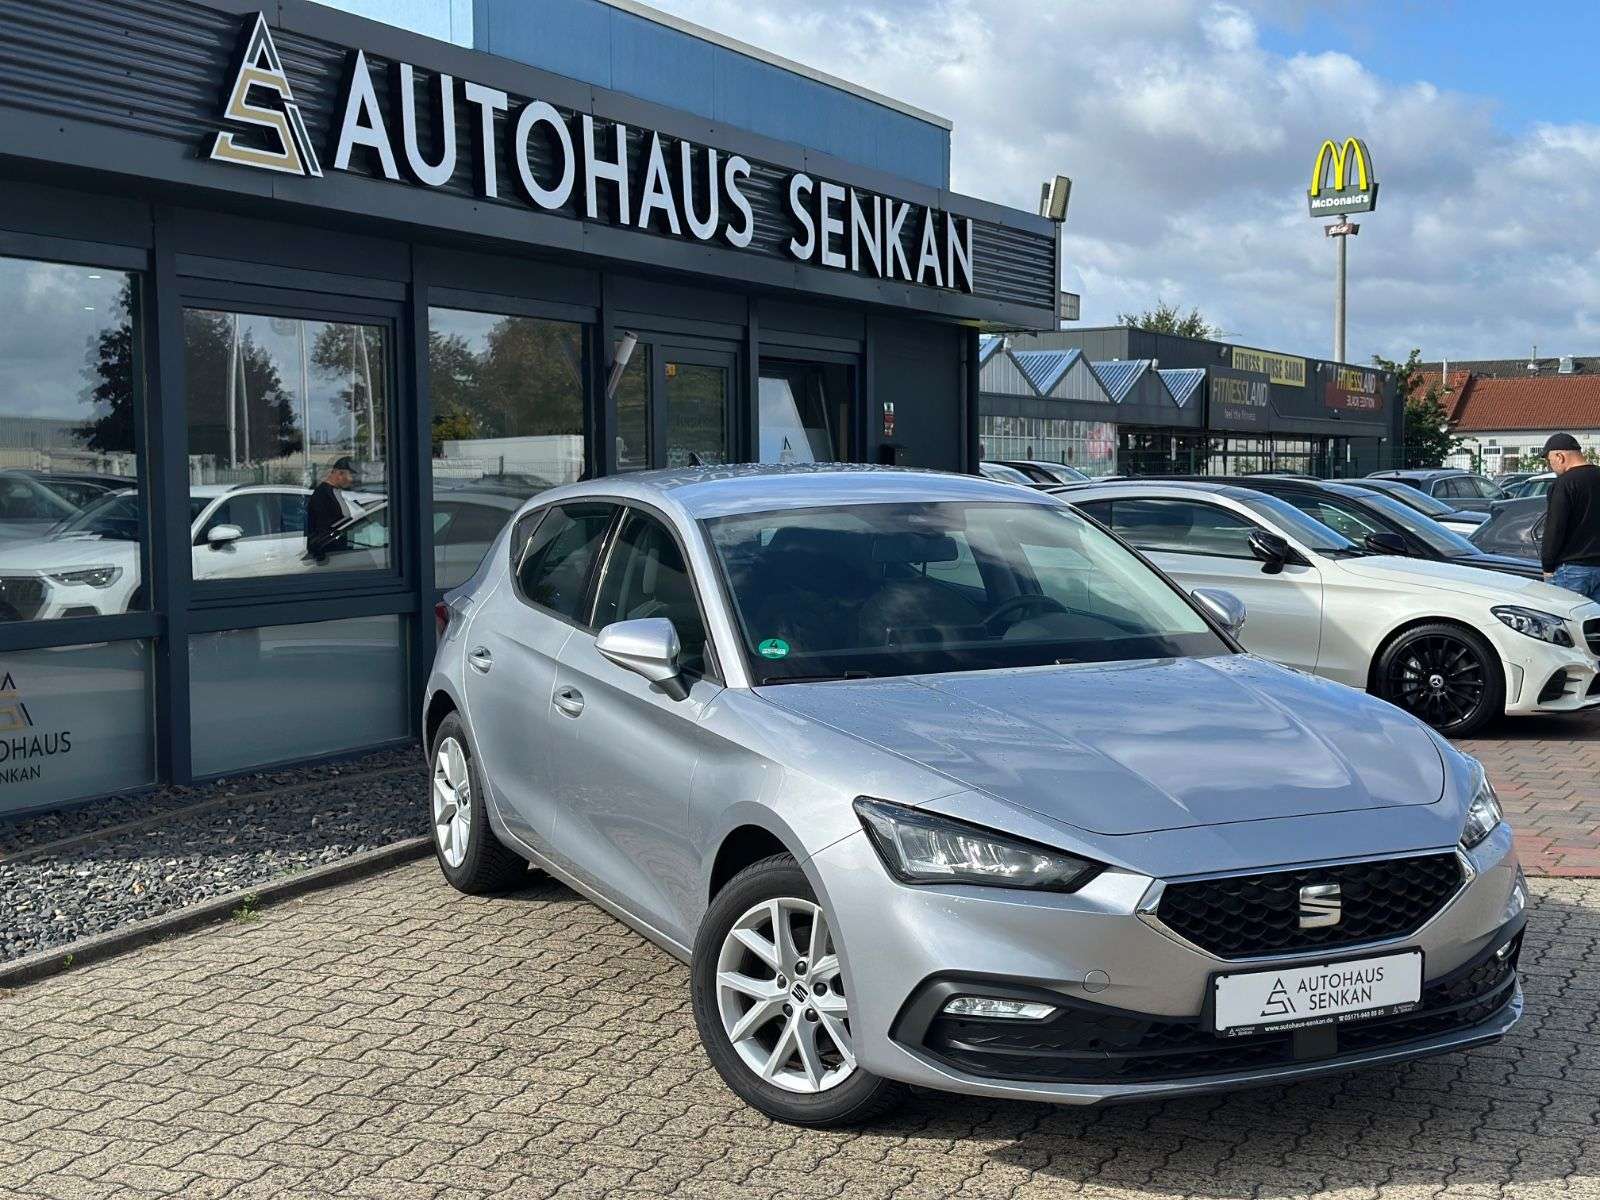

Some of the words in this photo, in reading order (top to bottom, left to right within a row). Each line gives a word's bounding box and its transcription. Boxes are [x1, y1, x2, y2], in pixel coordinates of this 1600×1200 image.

[334, 49, 754, 247] AUTOHAUS
[789, 173, 974, 293] SENKAN
[1311, 194, 1369, 208] McDonald's
[1297, 967, 1384, 993] AUTOHAUS
[1309, 985, 1372, 1010] SENKAN
